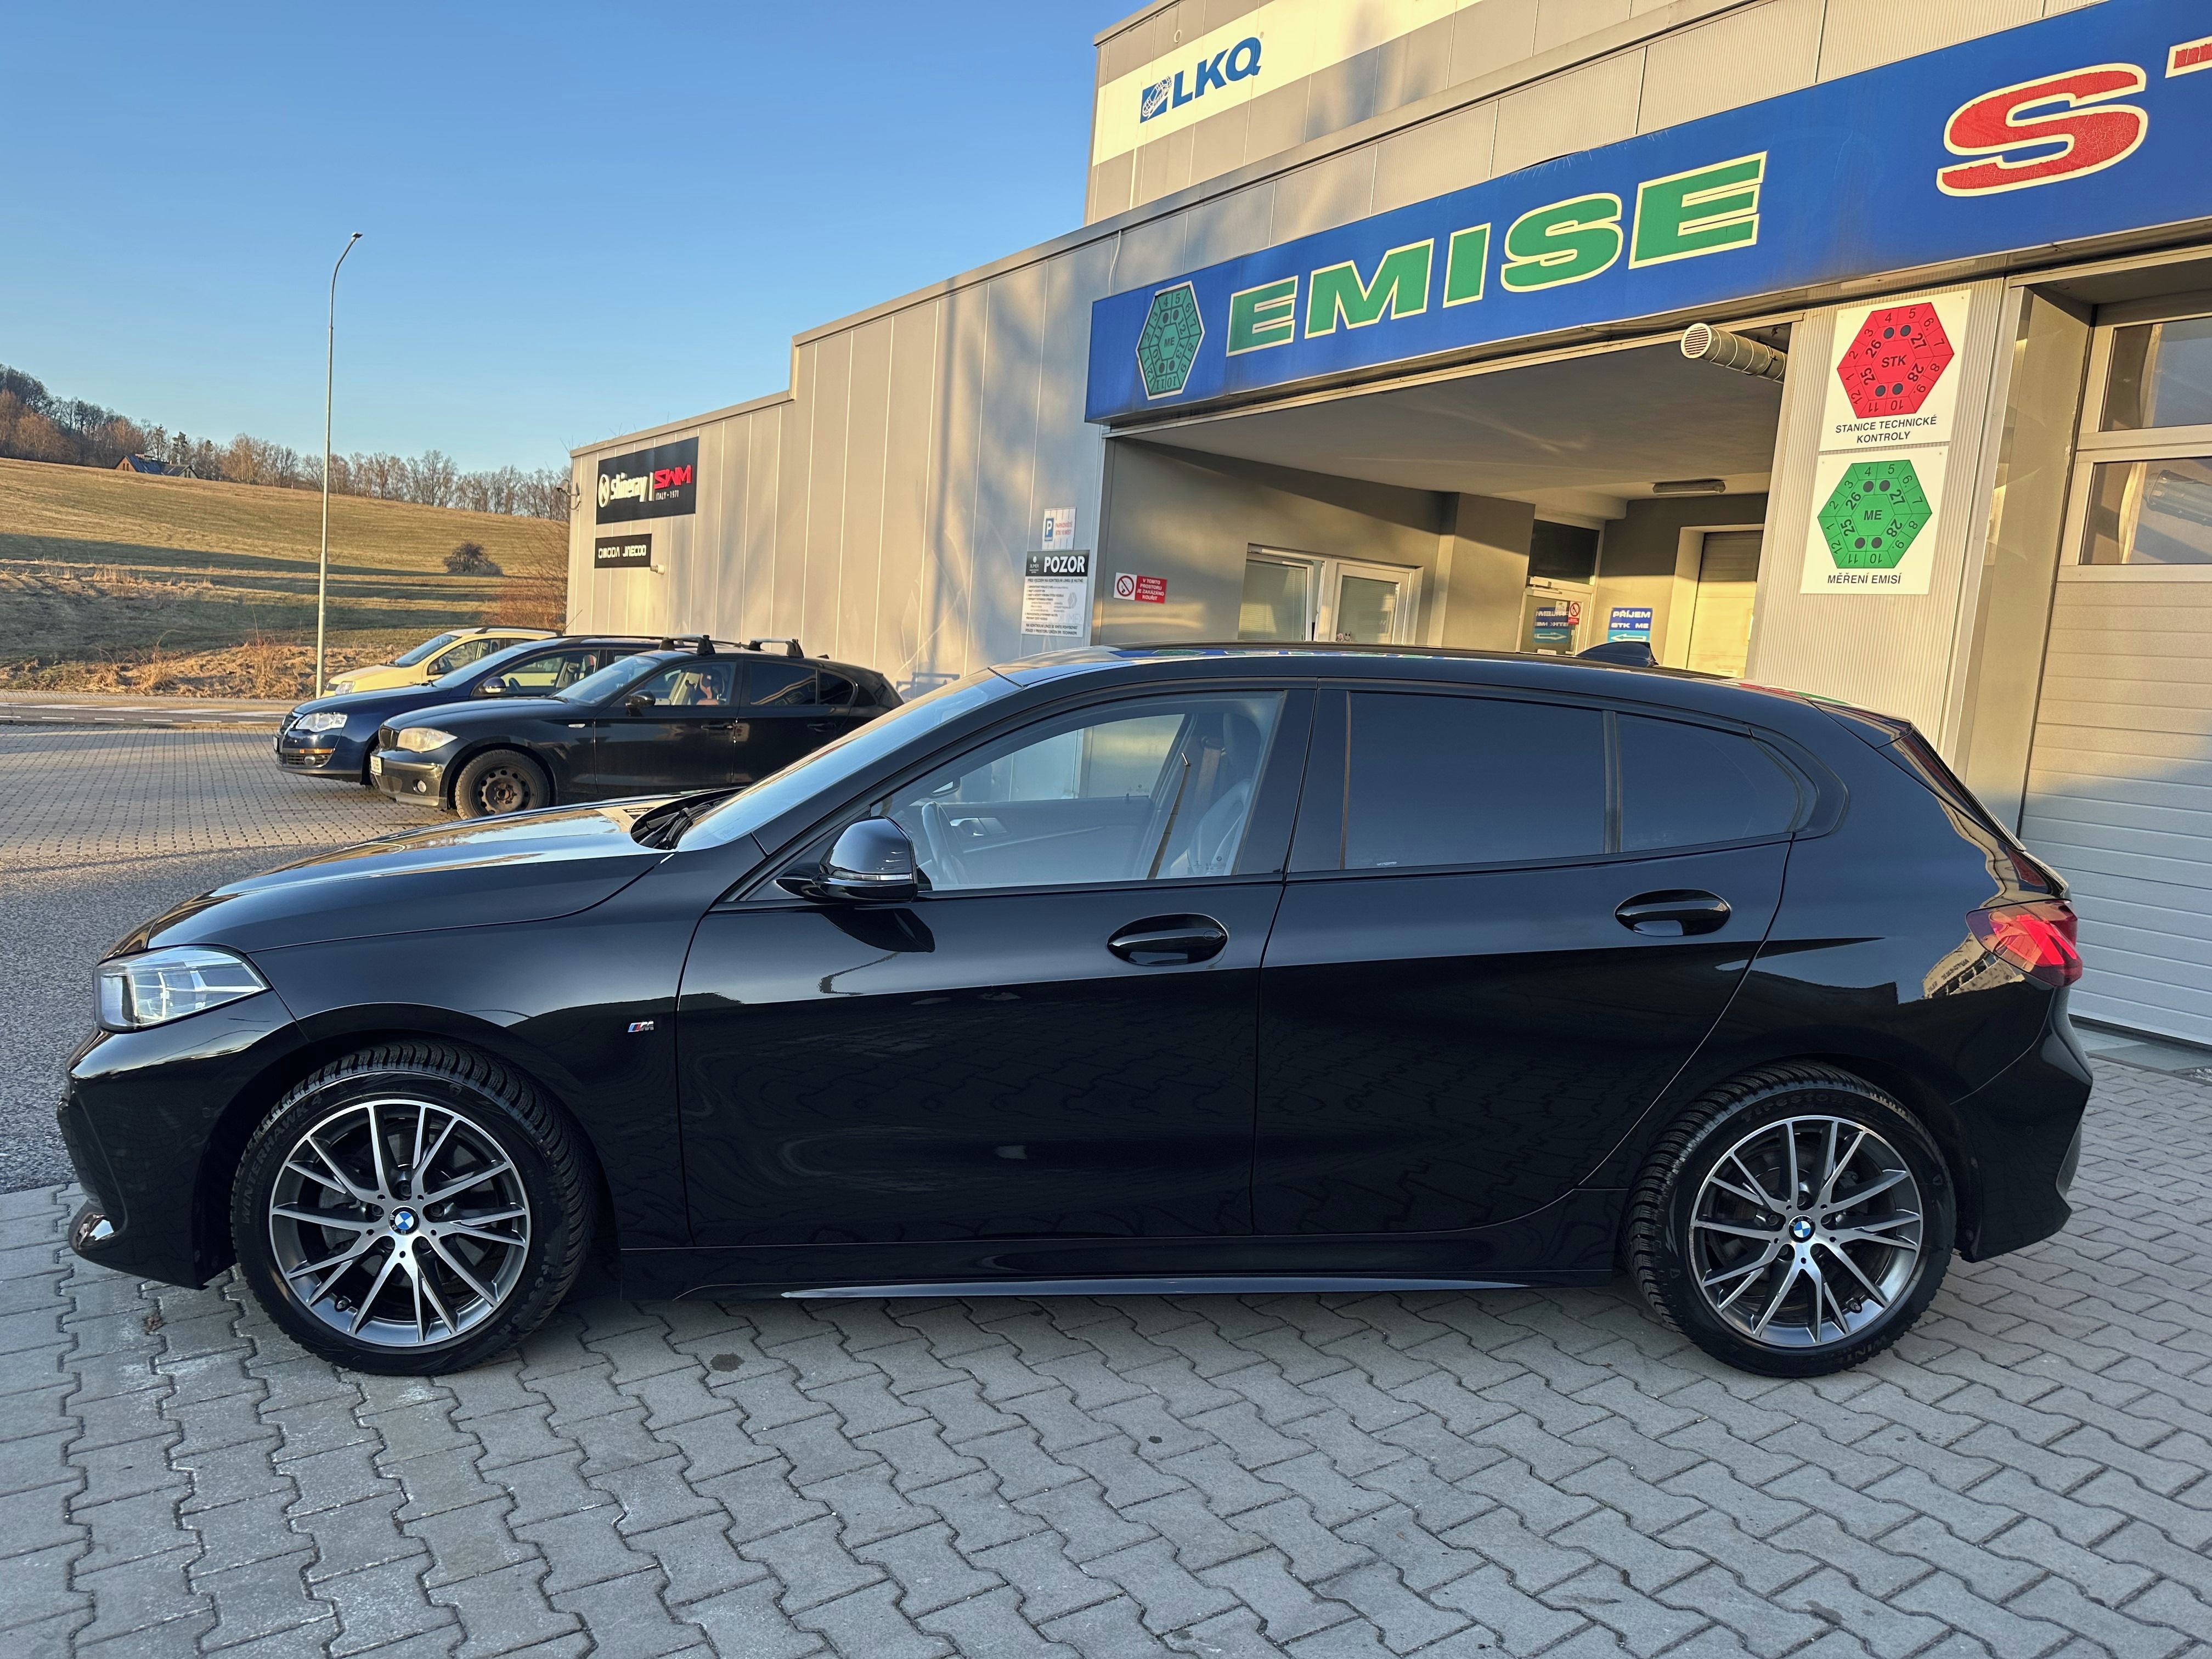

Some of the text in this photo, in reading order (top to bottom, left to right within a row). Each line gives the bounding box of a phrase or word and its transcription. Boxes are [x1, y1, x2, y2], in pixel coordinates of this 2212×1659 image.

[1172, 37, 1261, 109] LKQ
[1226, 36, 2212, 357] EMISE S
[1163, 296, 1168, 307] 4
[1175, 292, 1181, 304] 5
[1152, 311, 1158, 321] 3
[1884, 313, 1892, 323] 4
[1909, 308, 1916, 319] 5
[1190, 319, 1196, 328] 7
[1145, 332, 1151, 342] 2
[1864, 329, 1874, 337] 3
[1164, 336, 1175, 347] ME
[1910, 332, 1927, 349] 27
[1933, 338, 1945, 346] 7
[1187, 343, 1194, 352] 8
[1865, 339, 1882, 358] 26
[1849, 351, 1858, 359] 2
[1881, 354, 1907, 368] STK
[1908, 363, 1924, 382] 28
[1930, 363, 1940, 372] 8
[1167, 376, 1177, 387] 10
[1860, 368, 1875, 385] 25
[1156, 379, 1164, 390] 11
[1850, 390, 1863, 404] 12
[1868, 402, 1878, 413] 11
[1891, 399, 1904, 410] 10
[1835, 414, 1937, 433] STANICE TECHNICKÉ
[1857, 431, 1911, 443] KONTROLY
[1865, 466, 1871, 476] 4
[1888, 464, 1895, 475] 5
[1844, 481, 1853, 489] 3
[1846, 492, 1861, 510] 26
[1889, 489, 1905, 505] 27
[1829, 500, 1839, 510] 2
[1864, 510, 1882, 521] ME
[1046, 520, 1053, 535] P
[1840, 519, 1855, 537] 25
[1886, 519, 1903, 538] 28
[1908, 521, 1918, 529] 8
[1831, 540, 1842, 554] 12
[1848, 554, 1858, 564] 11
[1870, 553, 1882, 564] 10
[1043, 556, 1085, 573] POZOR
[1827, 572, 1902, 584] MĚŘENÍ EMISÍ
